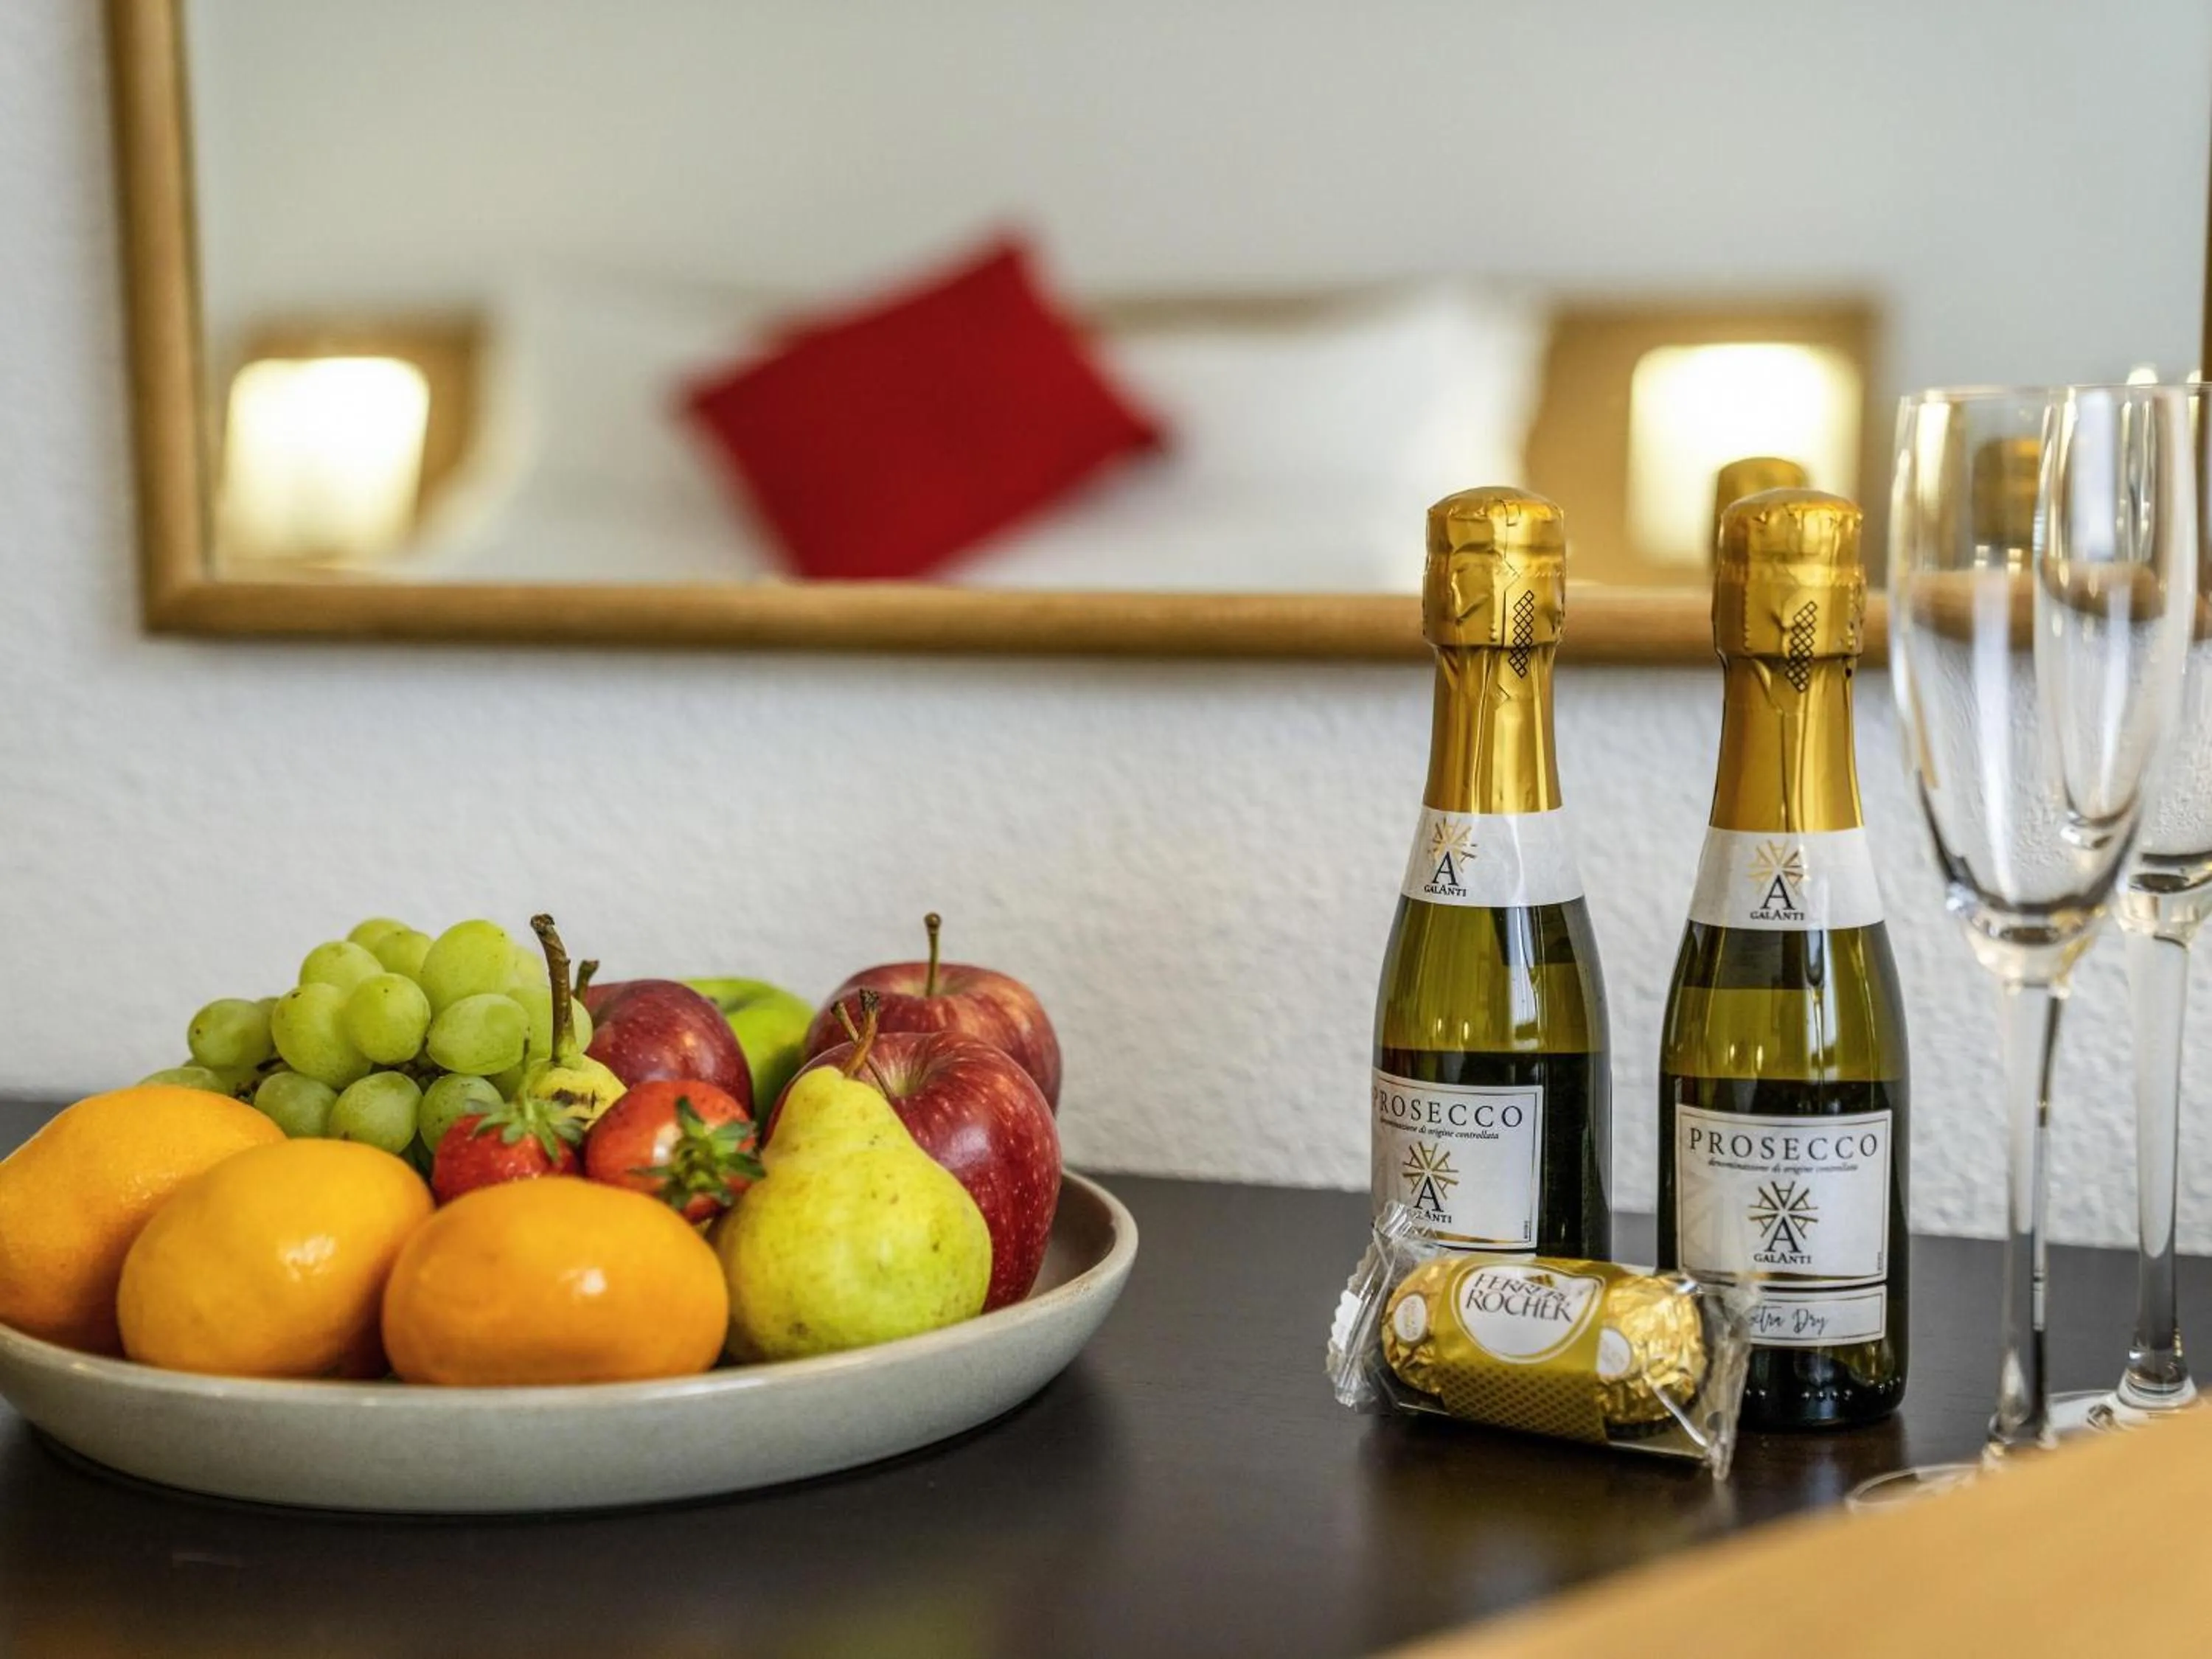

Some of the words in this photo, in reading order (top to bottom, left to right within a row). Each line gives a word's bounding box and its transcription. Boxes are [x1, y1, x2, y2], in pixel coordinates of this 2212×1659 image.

[1424, 884, 1467, 897] GALANTI
[1750, 909, 1806, 922] GALANTI
[1428, 1128, 1454, 1138] origine
[1455, 1130, 1499, 1140] controllata
[1689, 1127, 1878, 1161] PROSECCO
[1753, 1253, 1813, 1265] GALANTI
[1466, 1289, 1573, 1324] ROCHER
[1748, 1305, 1784, 1333] xtra
[1792, 1309, 1829, 1336] Dry
